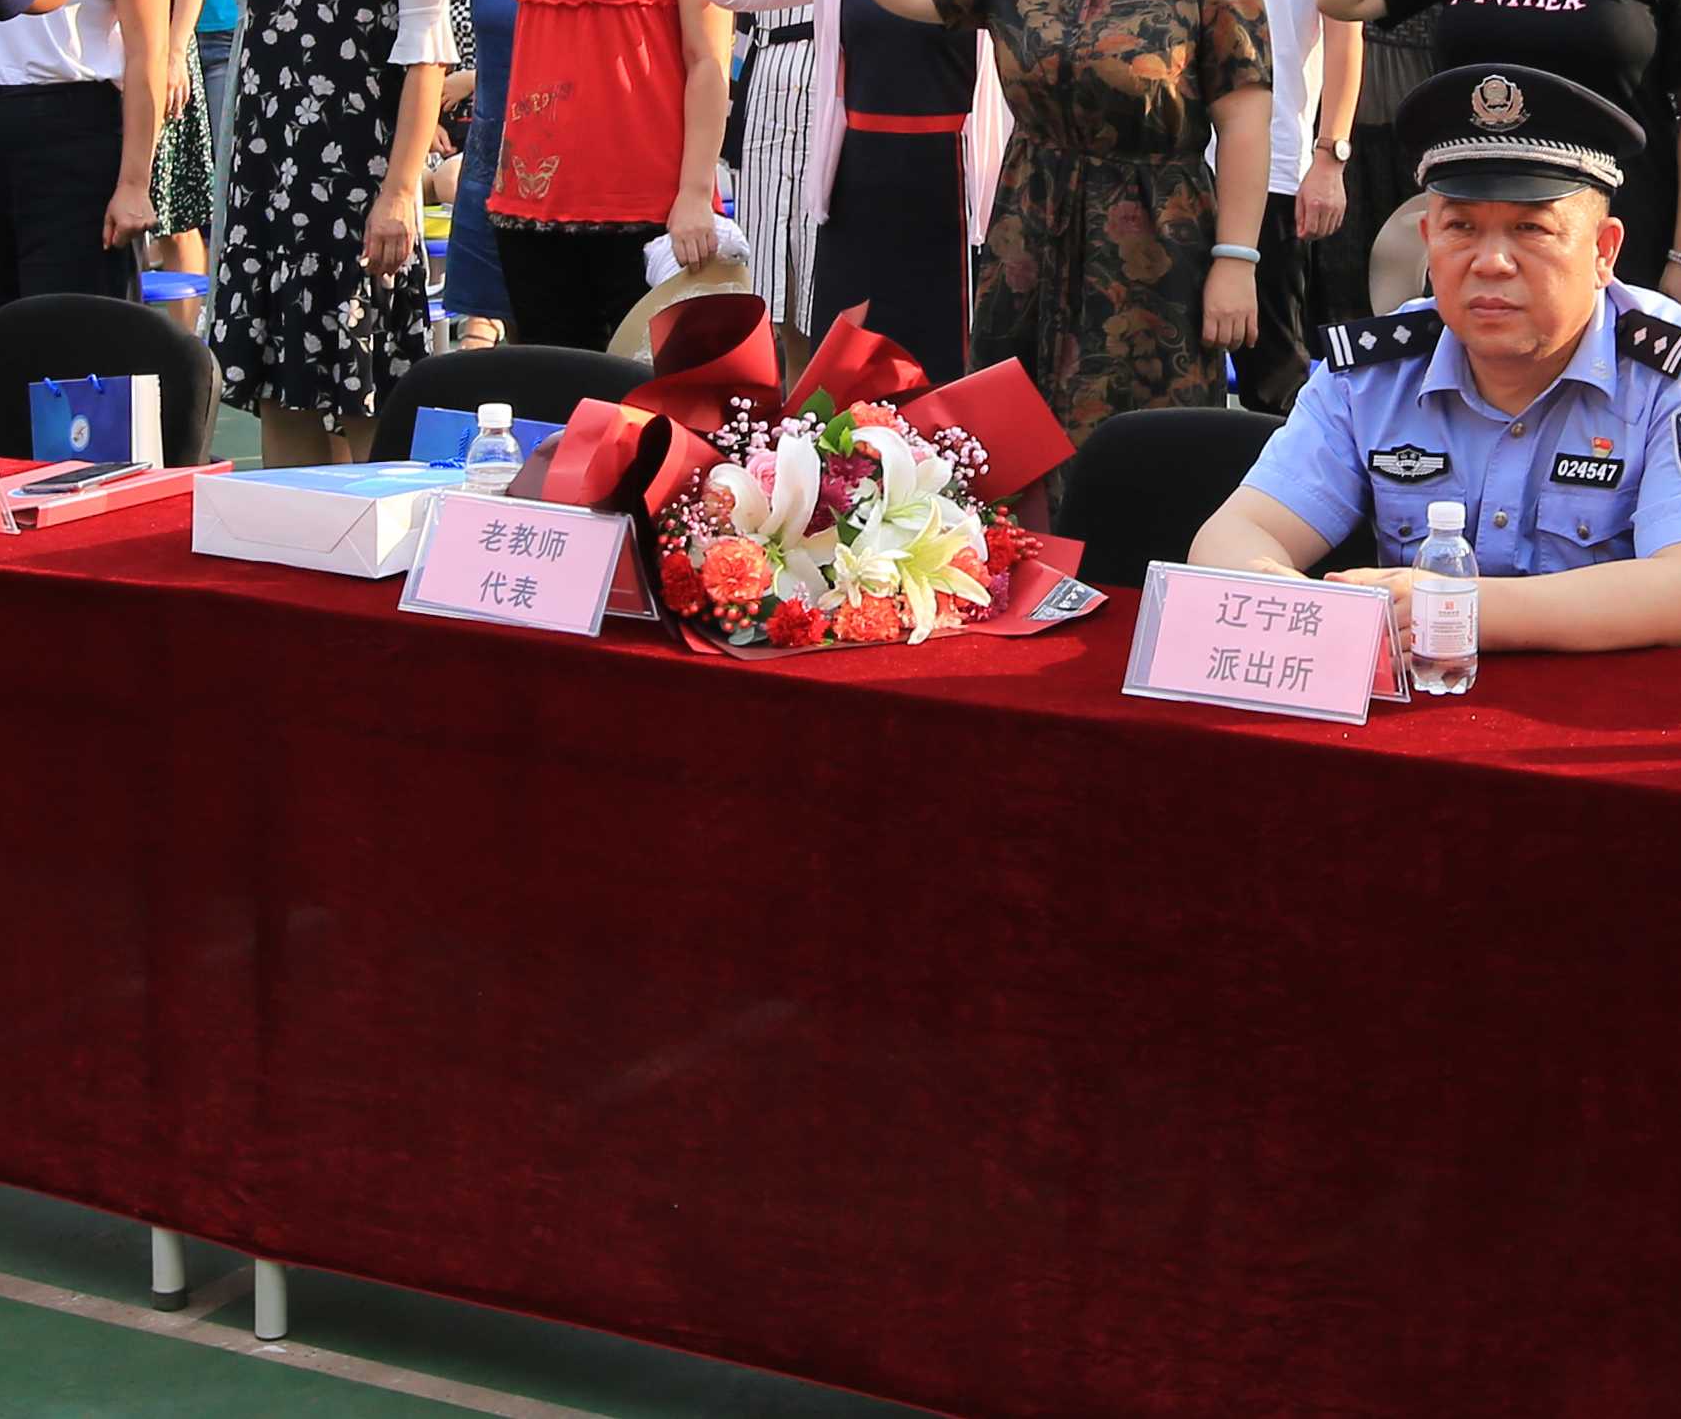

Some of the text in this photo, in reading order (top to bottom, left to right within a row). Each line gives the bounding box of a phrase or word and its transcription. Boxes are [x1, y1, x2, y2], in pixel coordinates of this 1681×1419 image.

[1556, 459, 1617, 481] 024547
[478, 519, 570, 563] 老教师
[478, 571, 540, 610] 代表
[1215, 592, 1324, 636] 辽宁路
[1206, 646, 1315, 694] 派出所
